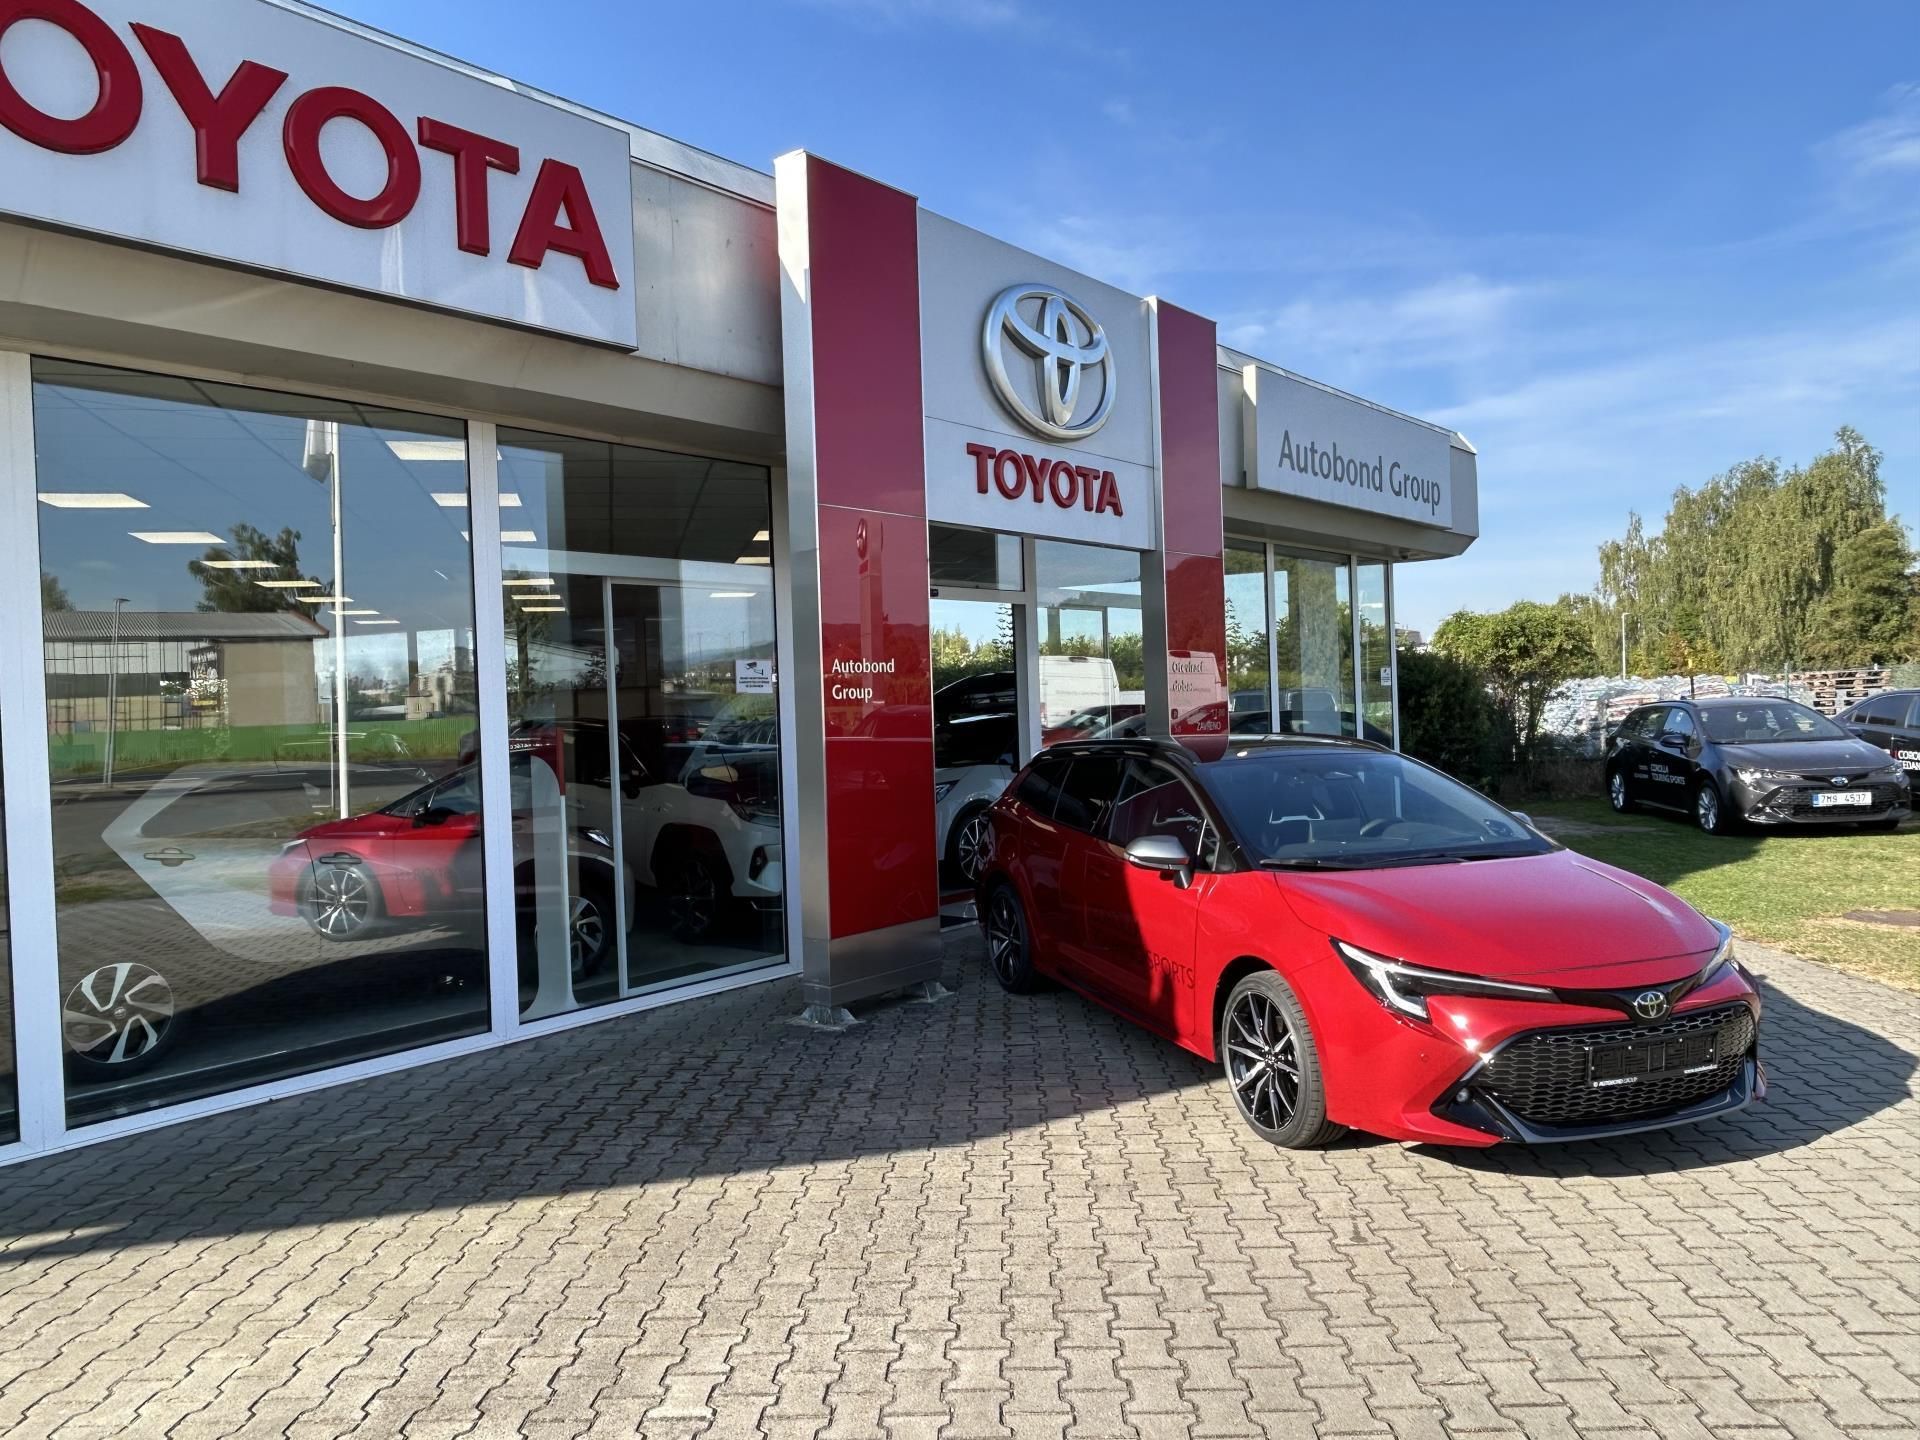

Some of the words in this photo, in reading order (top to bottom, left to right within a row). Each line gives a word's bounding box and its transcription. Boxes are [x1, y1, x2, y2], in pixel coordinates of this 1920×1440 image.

[966, 442, 1123, 517] TOYOTA
[1278, 429, 1383, 492] Autobond
[1389, 461, 1441, 516] Group
[832, 657, 895, 674] Autobond
[832, 684, 873, 704] Group
[1903, 761, 1920, 770] EDAN
